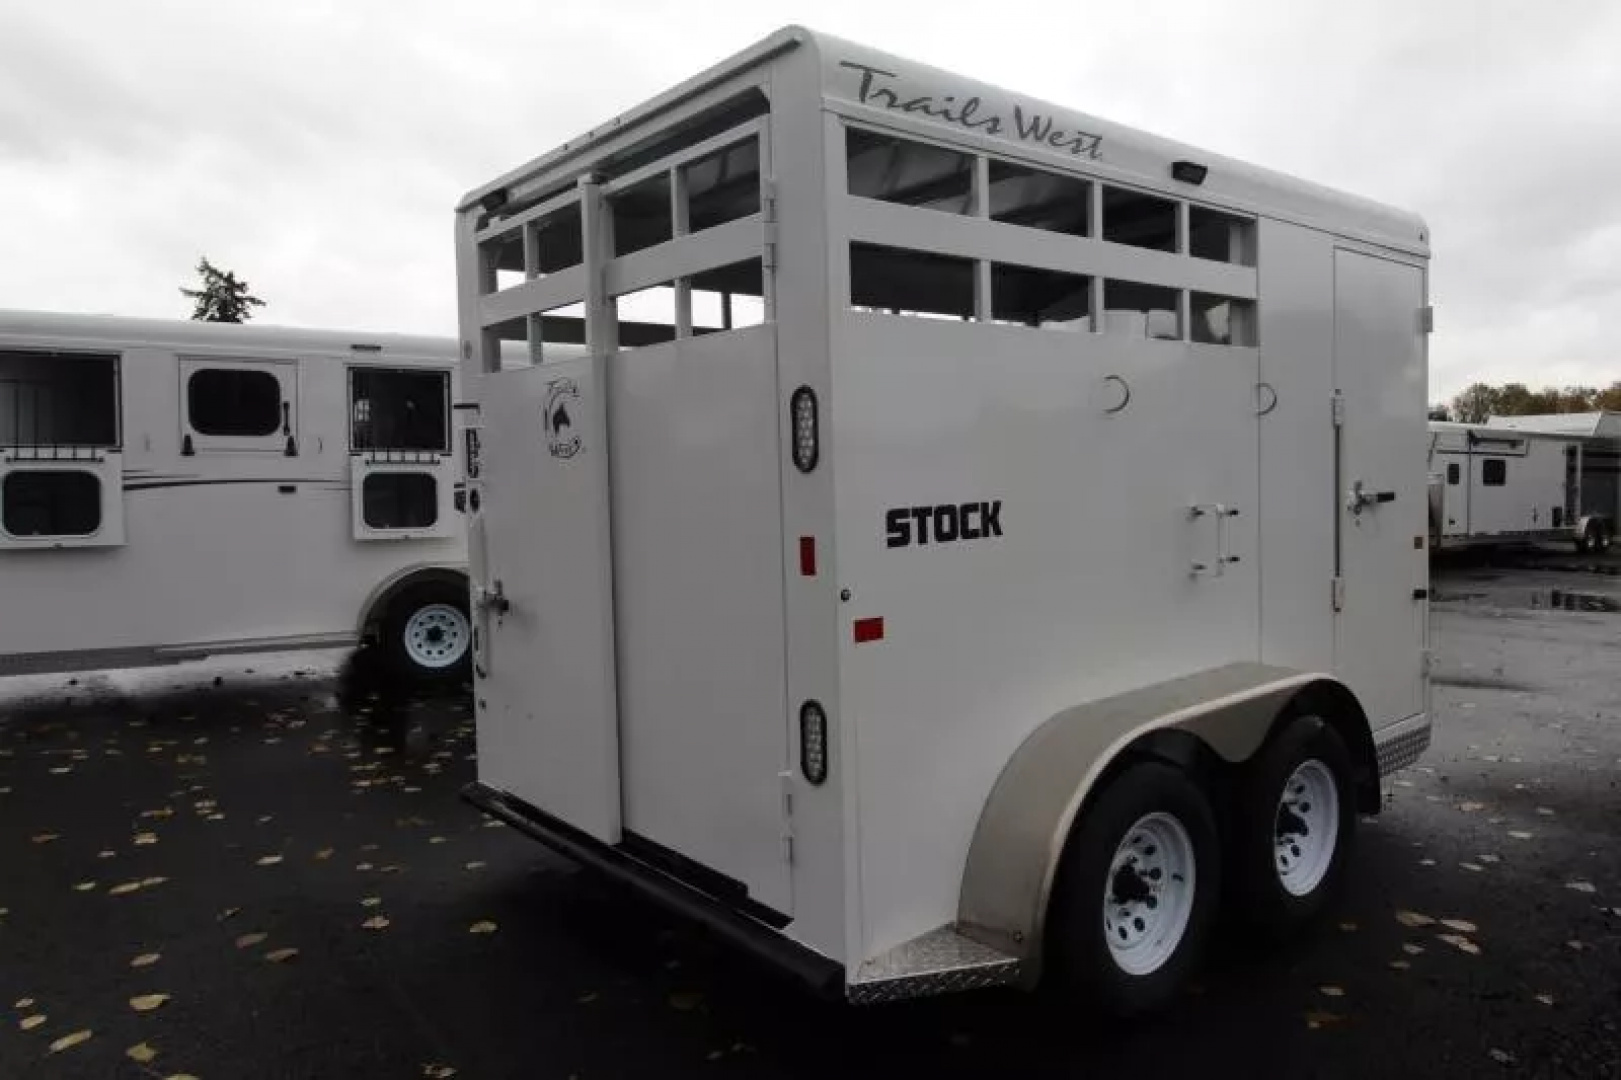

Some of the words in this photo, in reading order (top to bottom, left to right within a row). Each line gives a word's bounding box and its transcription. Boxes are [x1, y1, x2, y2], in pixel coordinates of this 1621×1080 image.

[839, 60, 1001, 134] Trails
[1014, 104, 1103, 159] West
[886, 500, 1003, 548] STOCK
